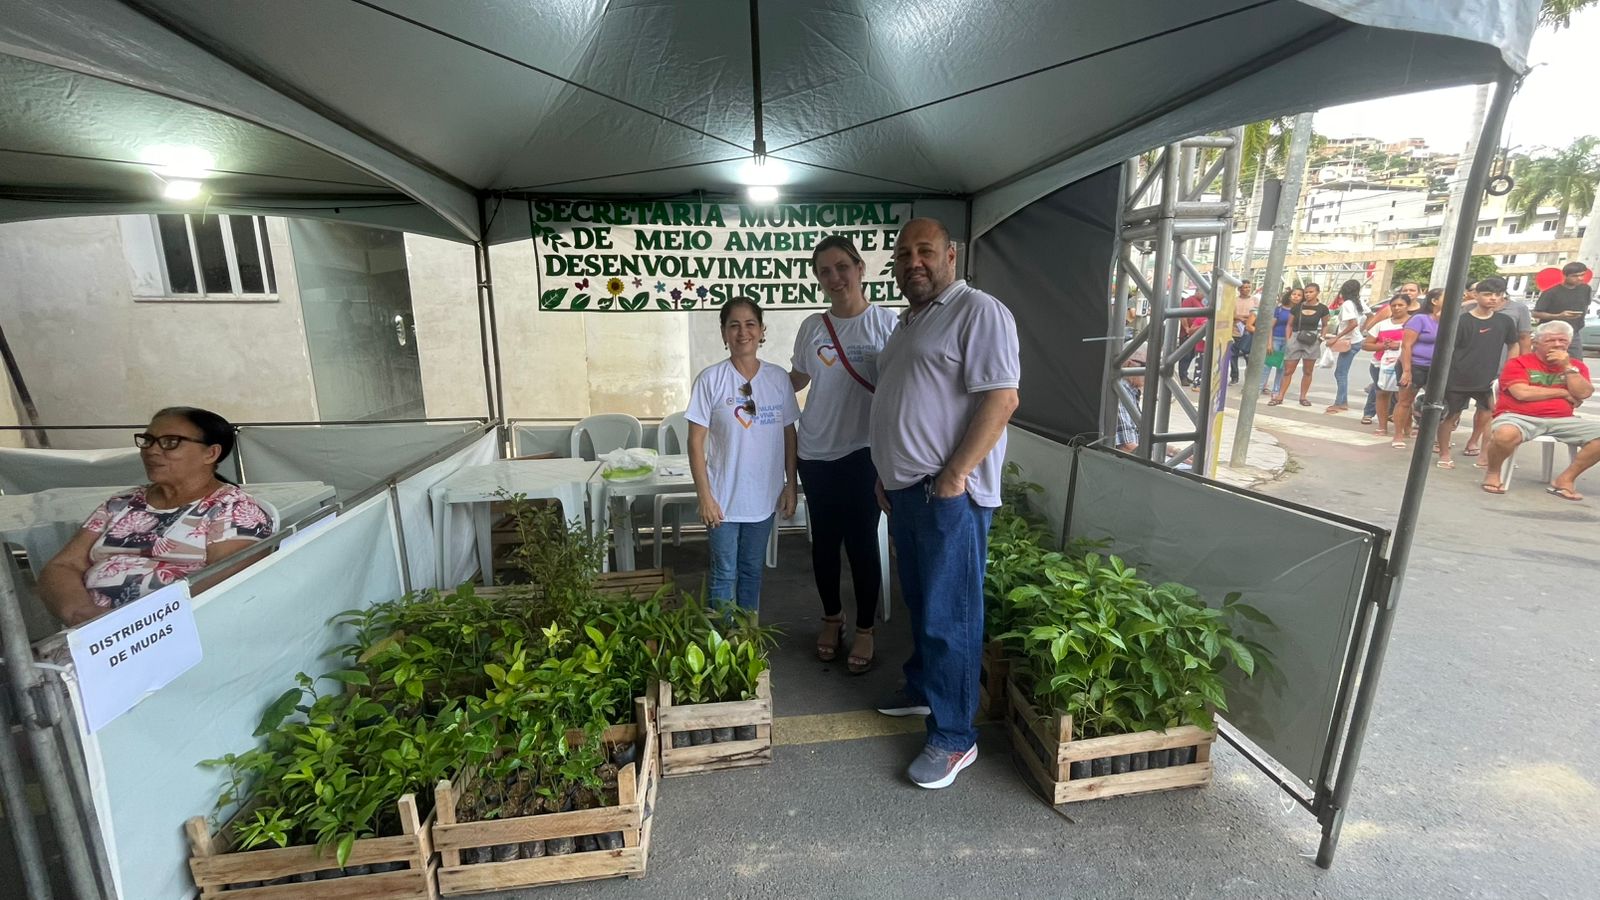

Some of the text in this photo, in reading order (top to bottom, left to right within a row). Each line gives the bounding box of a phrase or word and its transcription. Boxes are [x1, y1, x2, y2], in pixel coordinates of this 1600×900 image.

[534, 201, 900, 228] SECRETARIA MUNICIPAL
[572, 227, 613, 250] DE
[634, 230, 712, 250] MEIO
[543, 254, 814, 279] DESENVOLVIMENT
[89, 600, 180, 656] DISTRIBUIÇÃO
[109, 624, 174, 667] DE MUDAS
